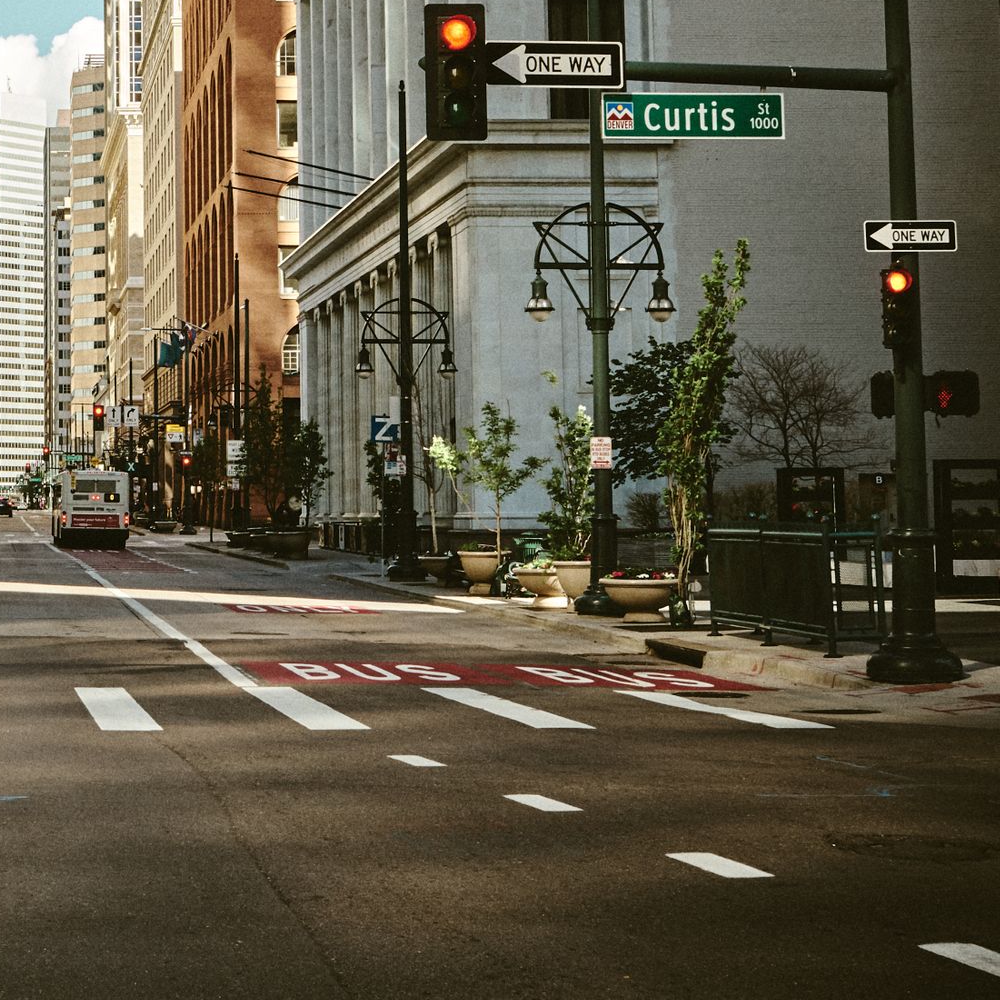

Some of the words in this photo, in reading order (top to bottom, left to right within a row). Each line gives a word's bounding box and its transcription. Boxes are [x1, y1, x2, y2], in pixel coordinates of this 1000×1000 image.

[526, 56, 562, 73] ONE
[568, 57, 606, 73] WAY
[644, 101, 736, 131] Curtis
[757, 103, 770, 115] St
[606, 120, 634, 130] DENVER
[750, 118, 779, 130] 1000
[892, 230, 917, 242] ONE
[920, 230, 946, 242] WAY
[876, 476, 882, 484] B
[236, 604, 359, 613] ONLY
[279, 662, 461, 682] BUS
[515, 666, 715, 688] BUS
